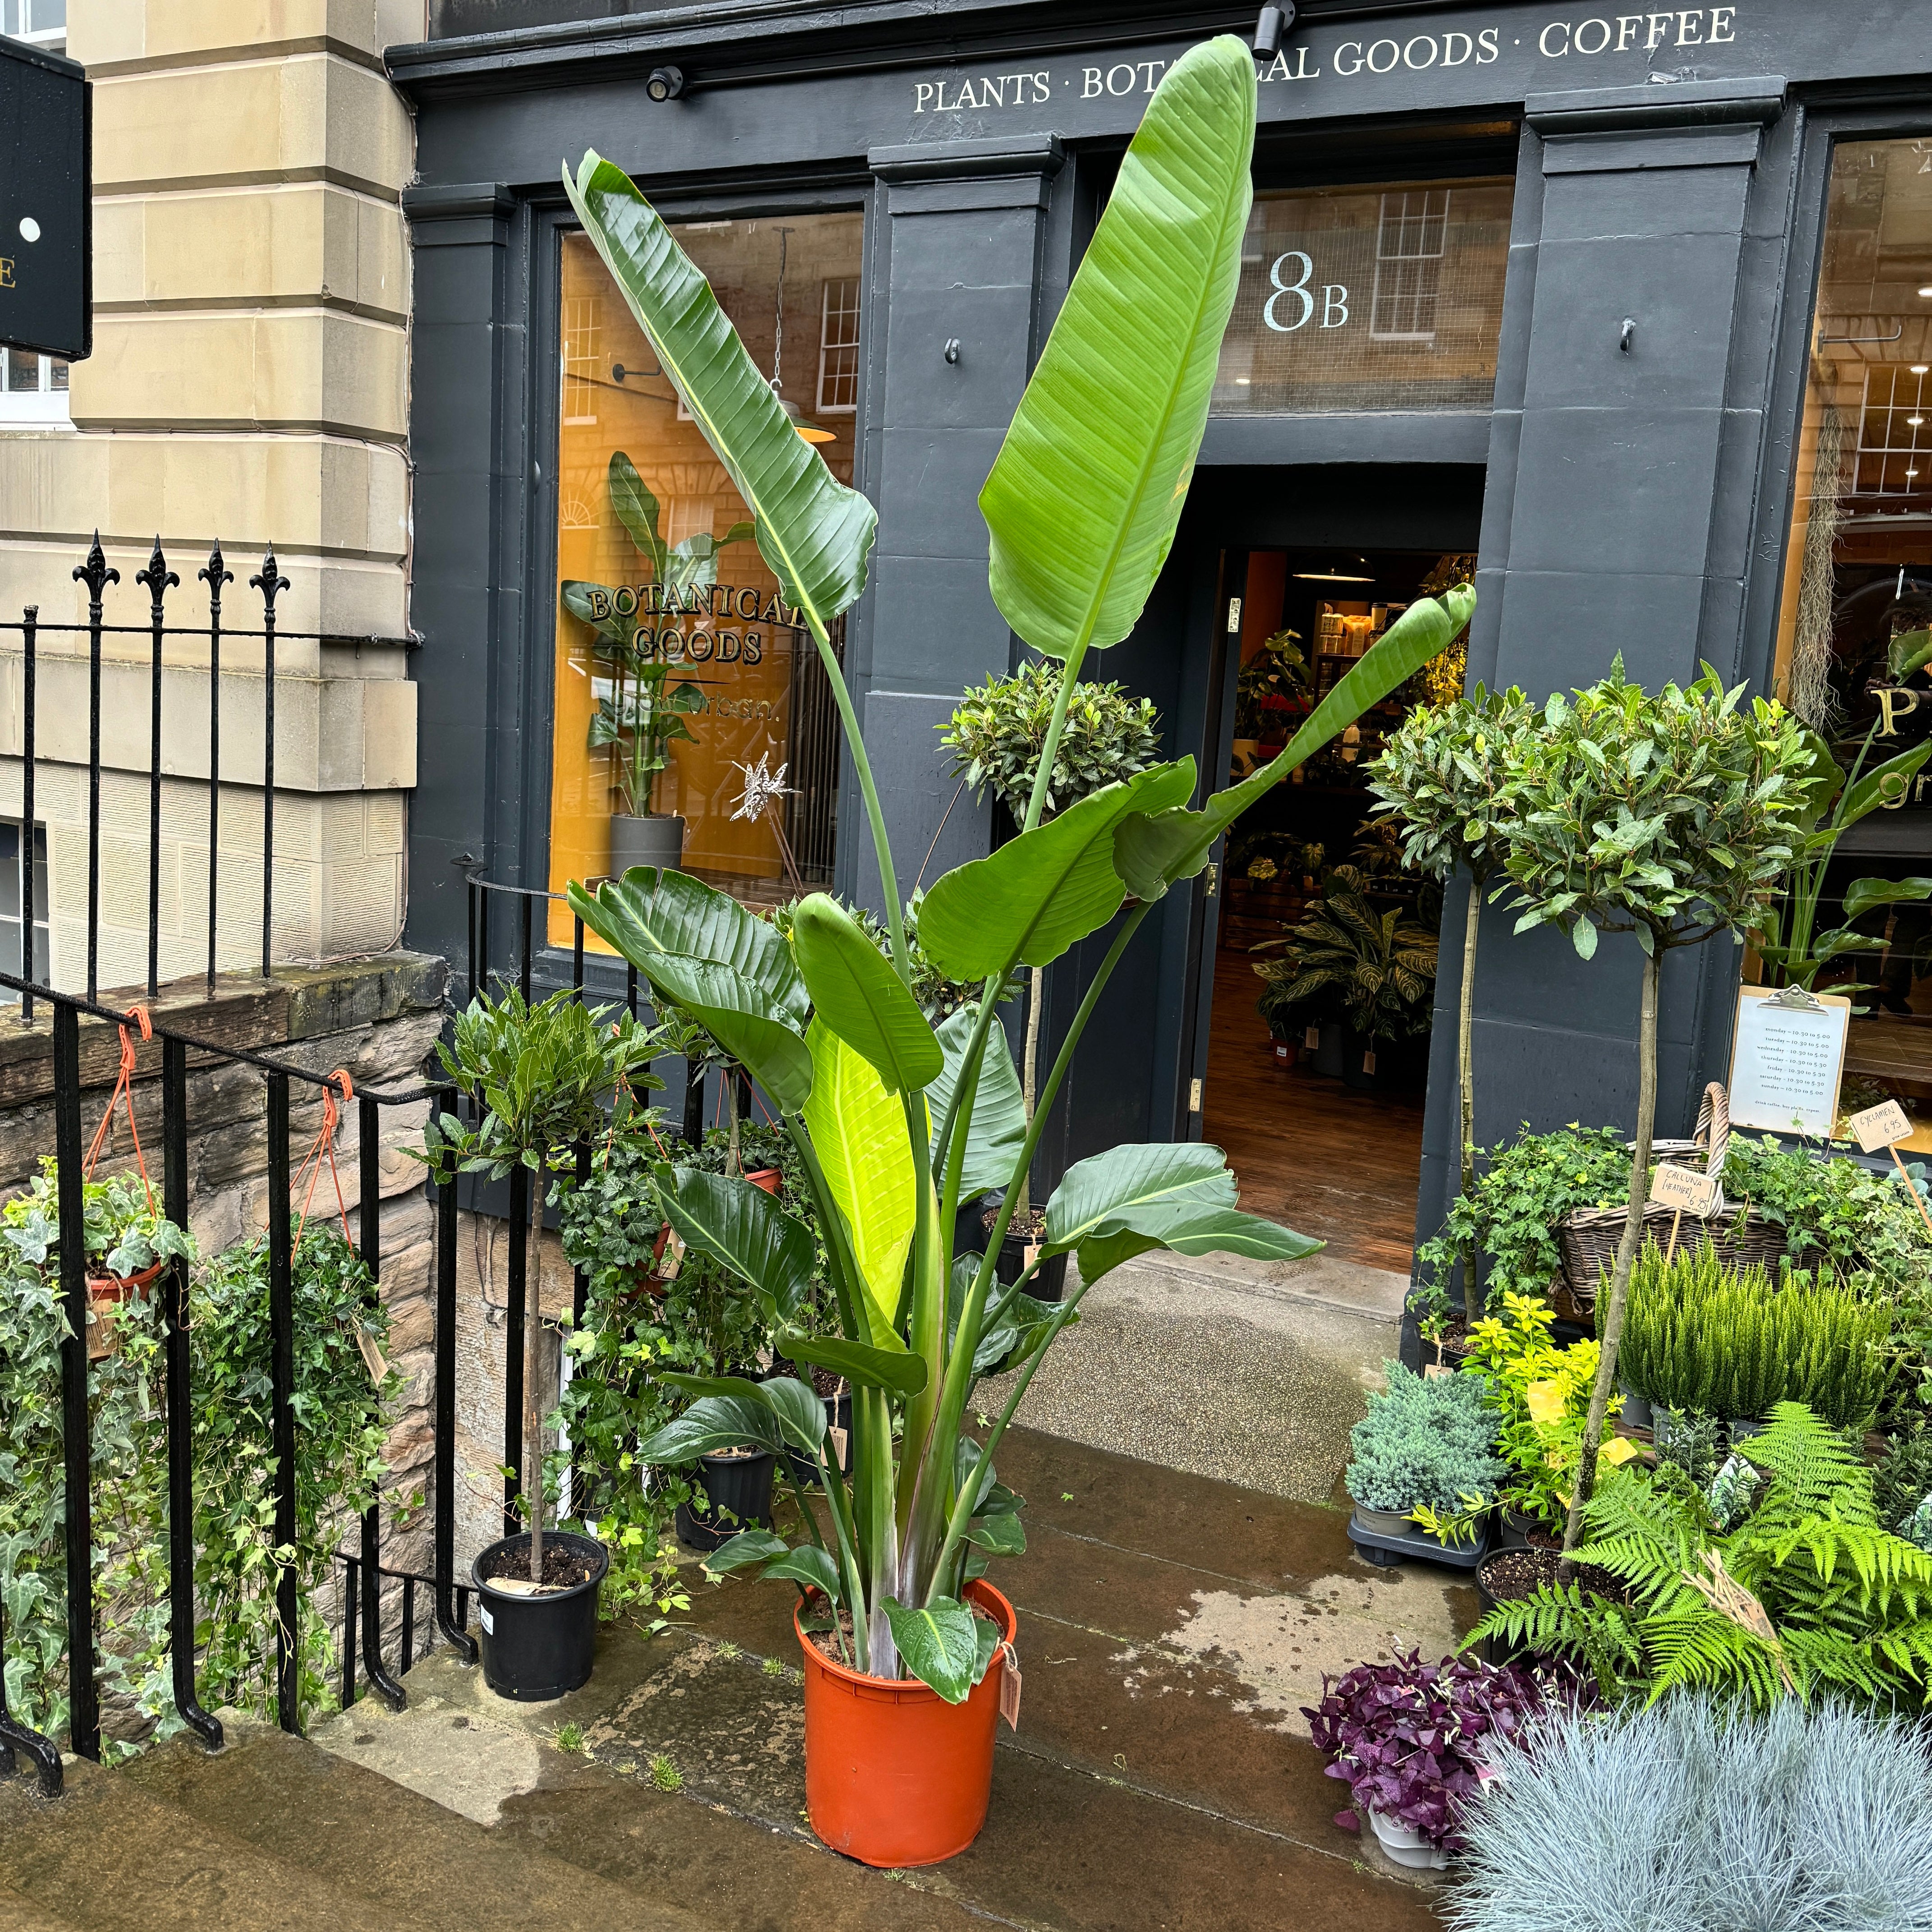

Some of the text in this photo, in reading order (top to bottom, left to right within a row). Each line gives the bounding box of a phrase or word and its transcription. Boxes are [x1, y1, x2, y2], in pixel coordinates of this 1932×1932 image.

[914, 71, 1050, 113] PLANTS
[1080, 47, 1320, 98] BOTAL
[1333, 28, 1500, 76] GOODS
[1539, 6, 1736, 57] COFFEE
[632, 626, 762, 665] GOODS
[1860, 1105, 1895, 1127] CYCLAMEN
[1666, 1170, 1702, 1187] CALLUNA
